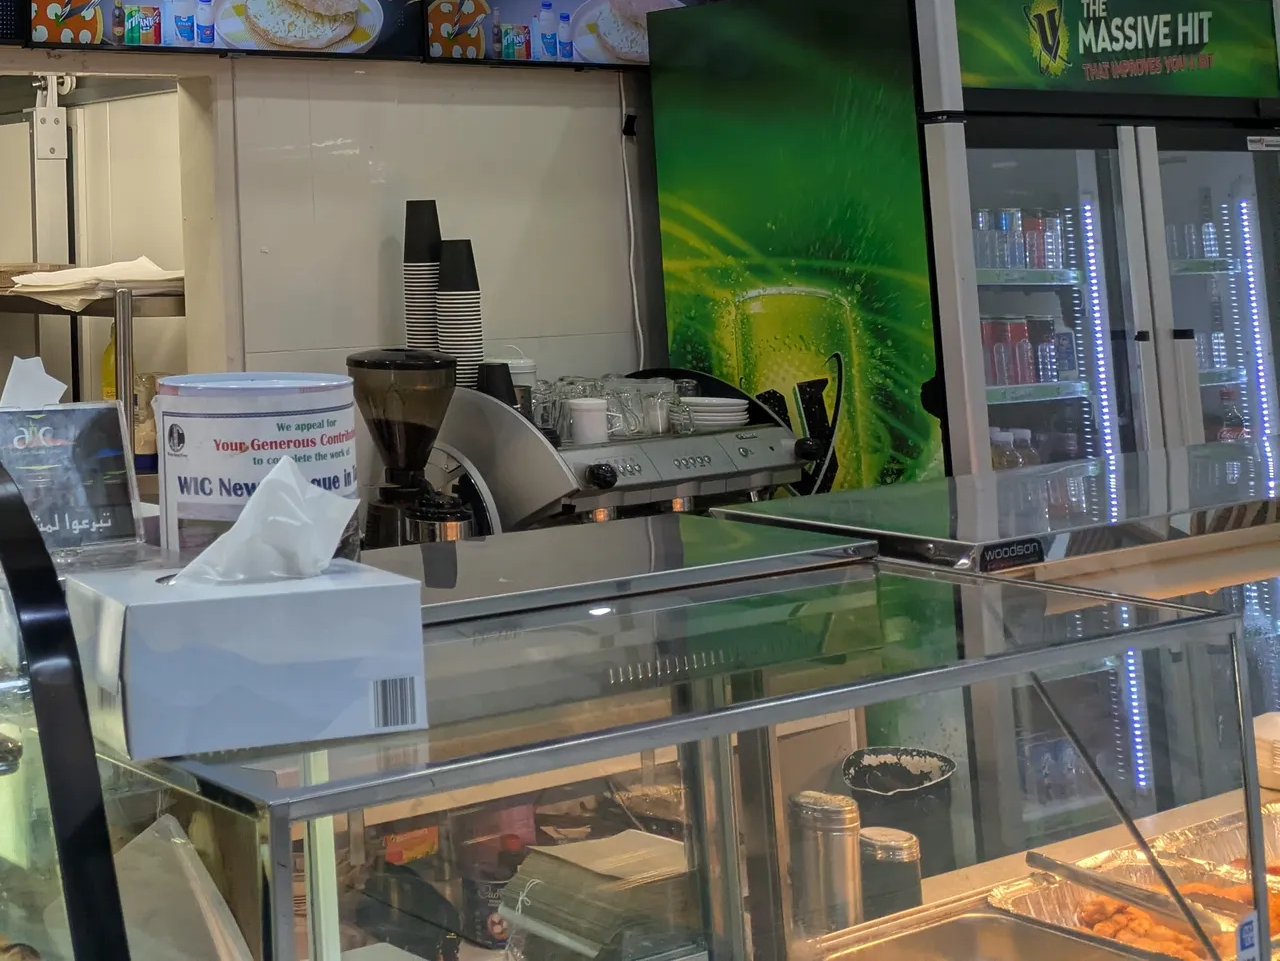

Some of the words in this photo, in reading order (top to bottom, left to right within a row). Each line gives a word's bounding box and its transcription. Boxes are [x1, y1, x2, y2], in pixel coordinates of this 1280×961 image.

[1078, 14, 1171, 54] MASSIVE
[1178, 11, 1212, 45] HIT
[1082, 62, 1109, 81] THAT
[1111, 57, 1162, 78] IMPROVES
[1164, 55, 1185, 73] YOU
[1198, 54, 1215, 69] BIT
[277, 423, 291, 432] We
[295, 420, 324, 432] appeal
[327, 419, 337, 428] for
[214, 439, 246, 452] Your
[251, 437, 316, 451] Generous
[253, 457, 263, 465] to
[267, 454, 312, 466] colete
[314, 452, 328, 462] the
[329, 451, 345, 460] work
[178, 476, 212, 496] WIC
[219, 478, 260, 497] New
[344, 468, 351, 486] in
[985, 543, 1038, 560] woodson
